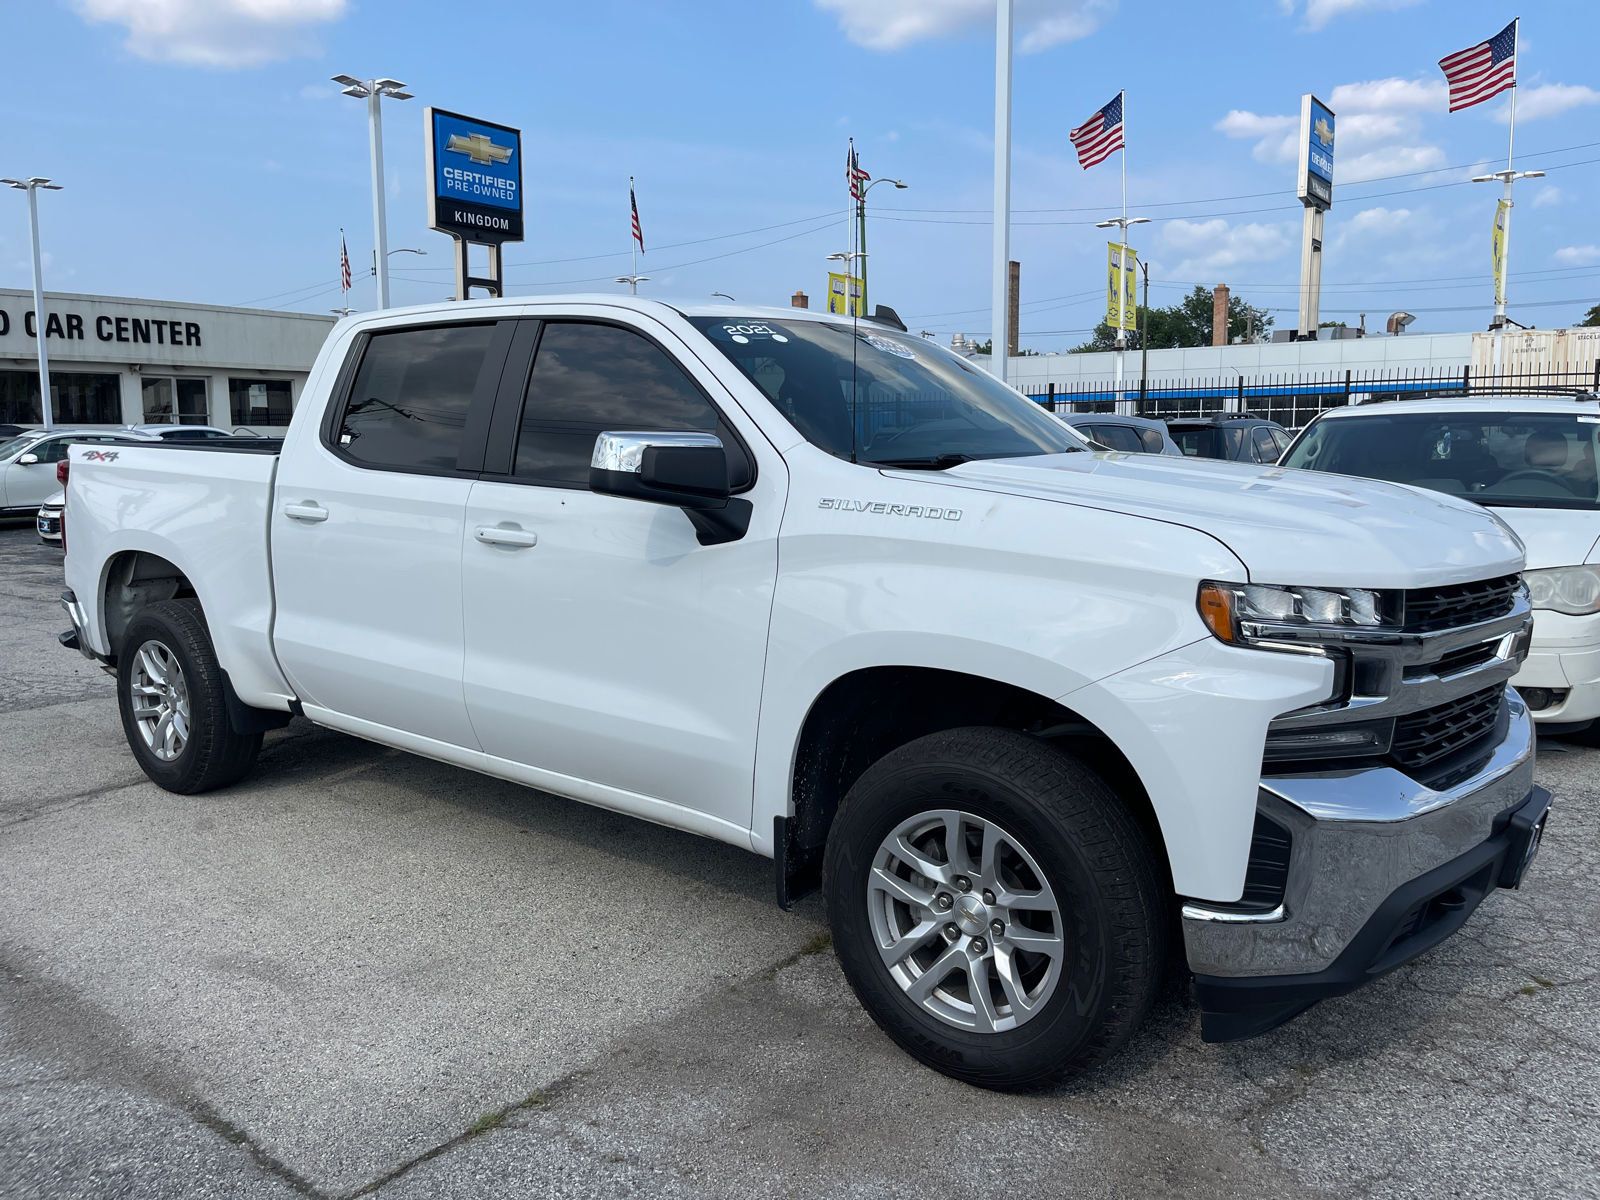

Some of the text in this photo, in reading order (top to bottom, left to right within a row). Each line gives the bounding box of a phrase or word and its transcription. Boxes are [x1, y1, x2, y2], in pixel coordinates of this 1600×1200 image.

[443, 167, 516, 190] CERTIFIED
[447, 179, 514, 201] PRE-OWNED
[454, 210, 509, 230] KINGDOM
[24, 310, 84, 340] CAR
[96, 315, 202, 347] CENTER
[722, 325, 777, 335] 2021
[818, 497, 963, 522] SILVERADO
[941, 779, 1093, 974] GOODYEAR
